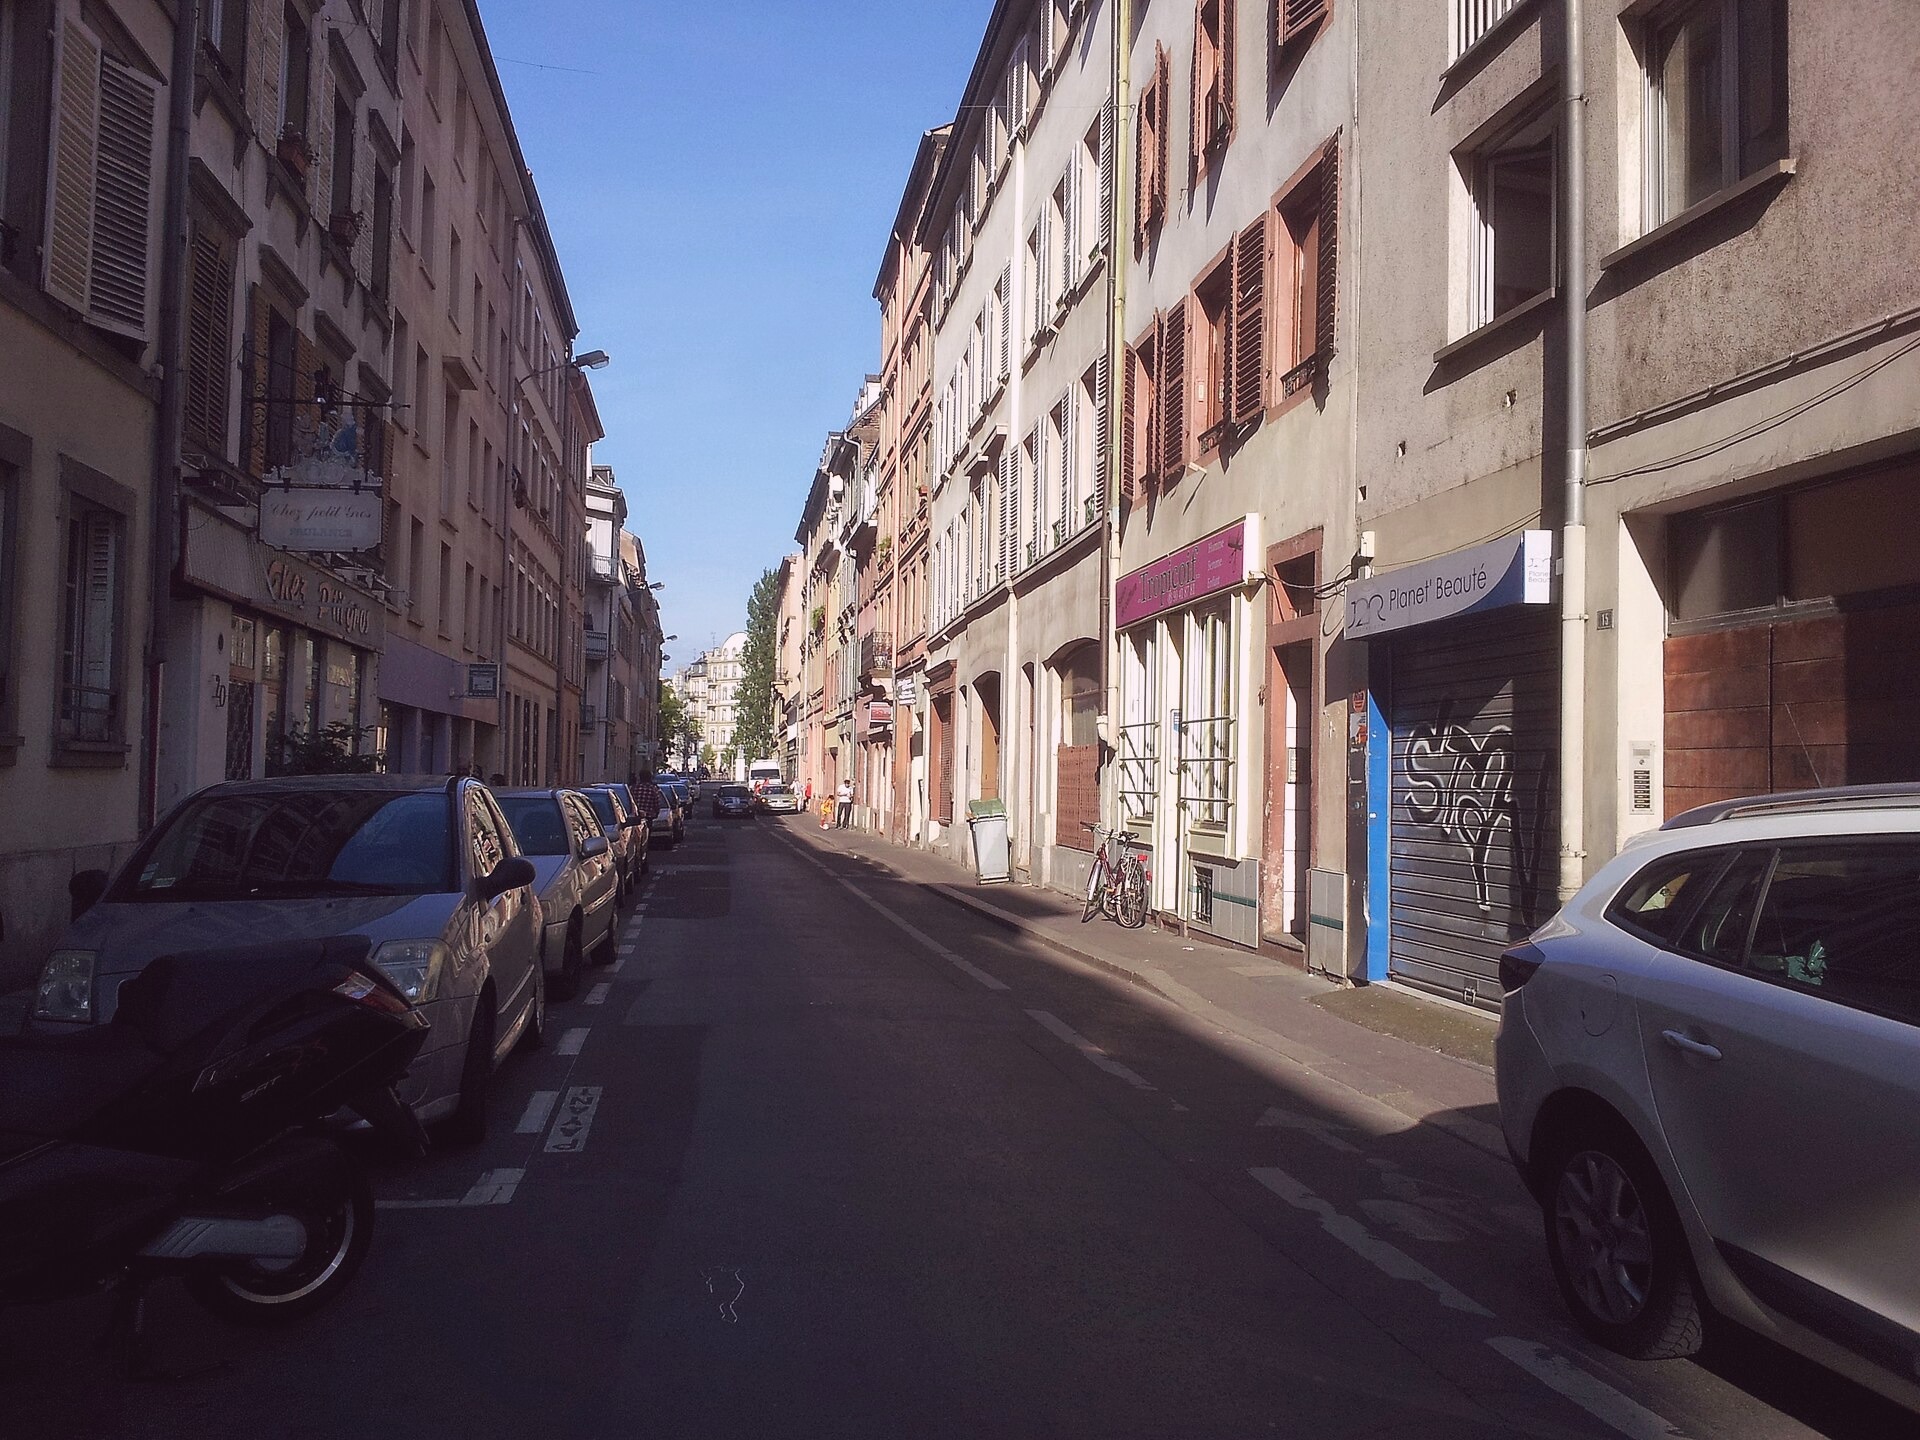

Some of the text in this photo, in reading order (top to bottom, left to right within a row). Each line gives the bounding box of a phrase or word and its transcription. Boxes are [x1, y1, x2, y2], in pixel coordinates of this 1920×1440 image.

[270, 502, 302, 522] Chez
[268, 560, 308, 609] Chez
[1138, 546, 1200, 608] Tropicoif
[1436, 562, 1487, 600] Beauté
[1601, 612, 1610, 626] 15
